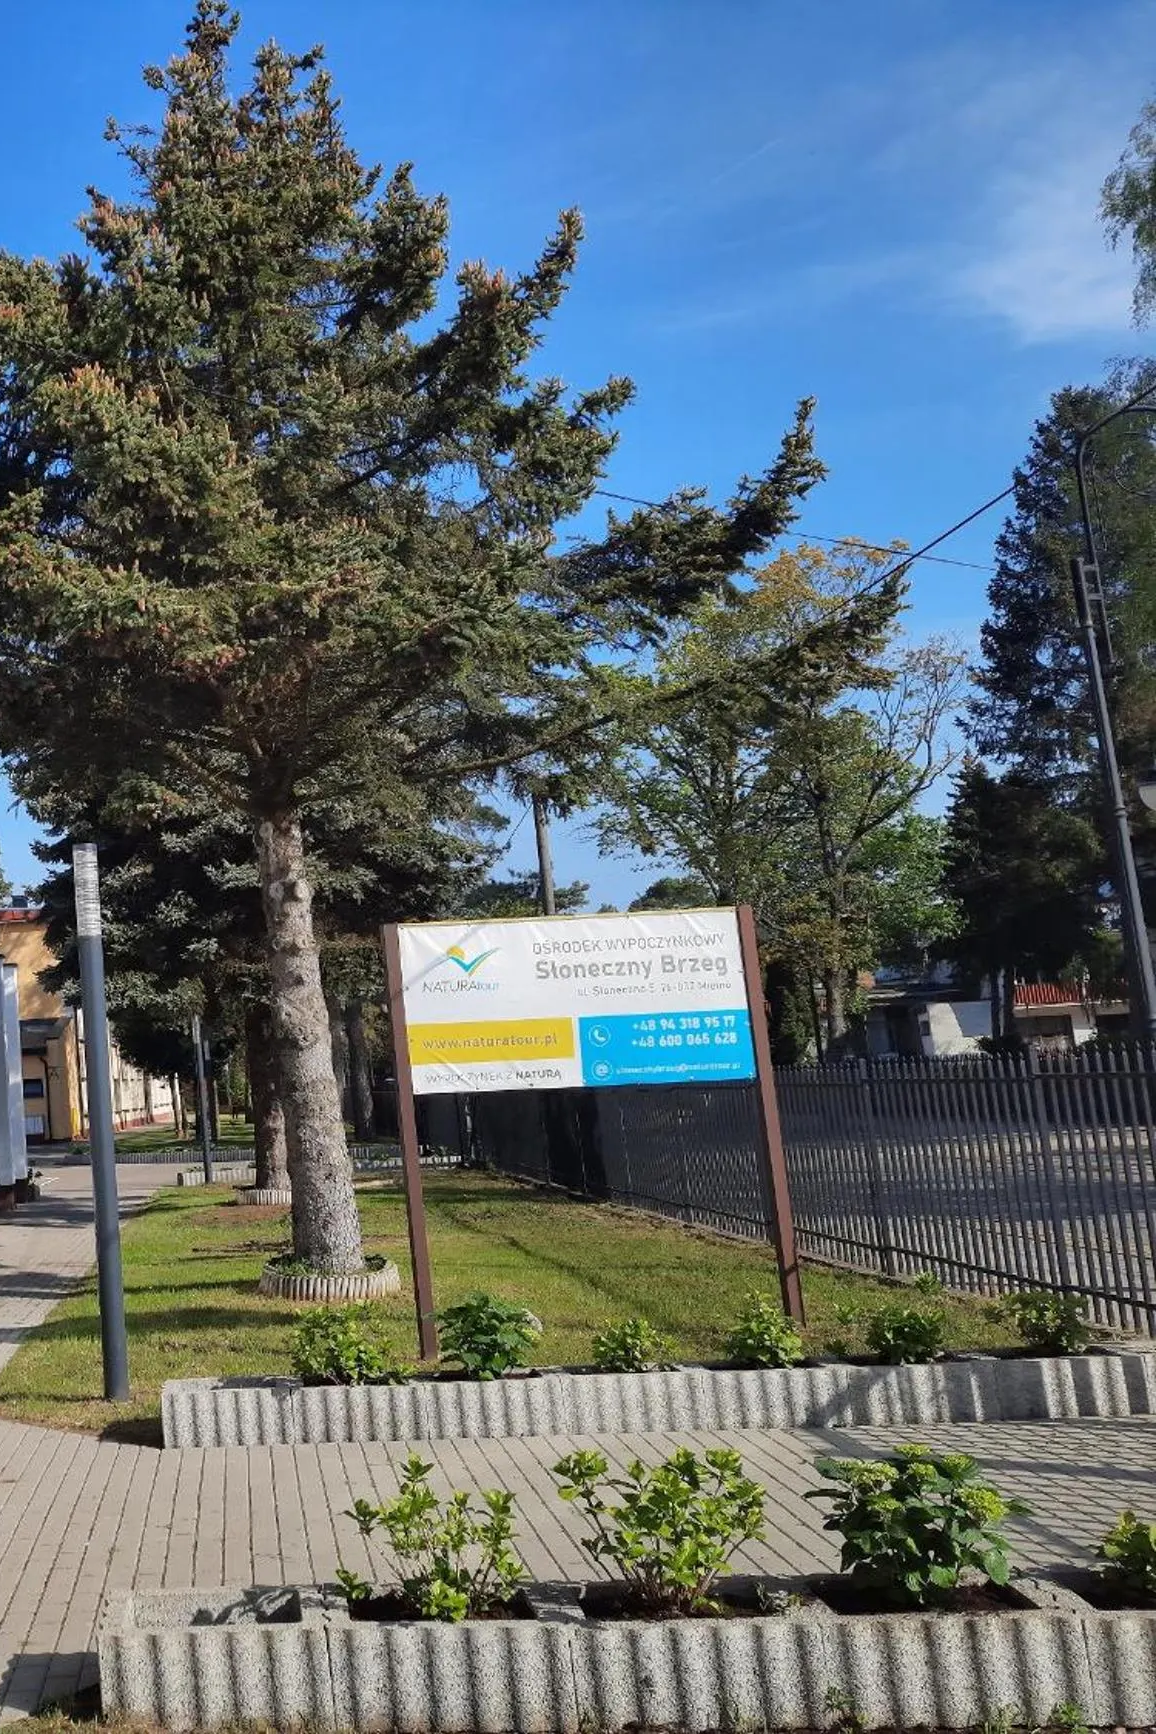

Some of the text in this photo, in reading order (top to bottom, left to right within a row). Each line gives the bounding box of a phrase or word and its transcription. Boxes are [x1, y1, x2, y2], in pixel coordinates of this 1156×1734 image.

[532, 933, 726, 955] OŚRODEK WYPOCZYNKOWY
[535, 954, 729, 980] Słoneczny Brzeg
[632, 1019, 657, 1032] +48
[659, 1018, 676, 1031] 94
[679, 1017, 701, 1030] 318
[704, 1016, 720, 1029] 95
[422, 1033, 558, 1050] www.naturatour.pl
[631, 1035, 656, 1048] +48
[659, 1034, 683, 1047] 600
[714, 1031, 738, 1045] 628
